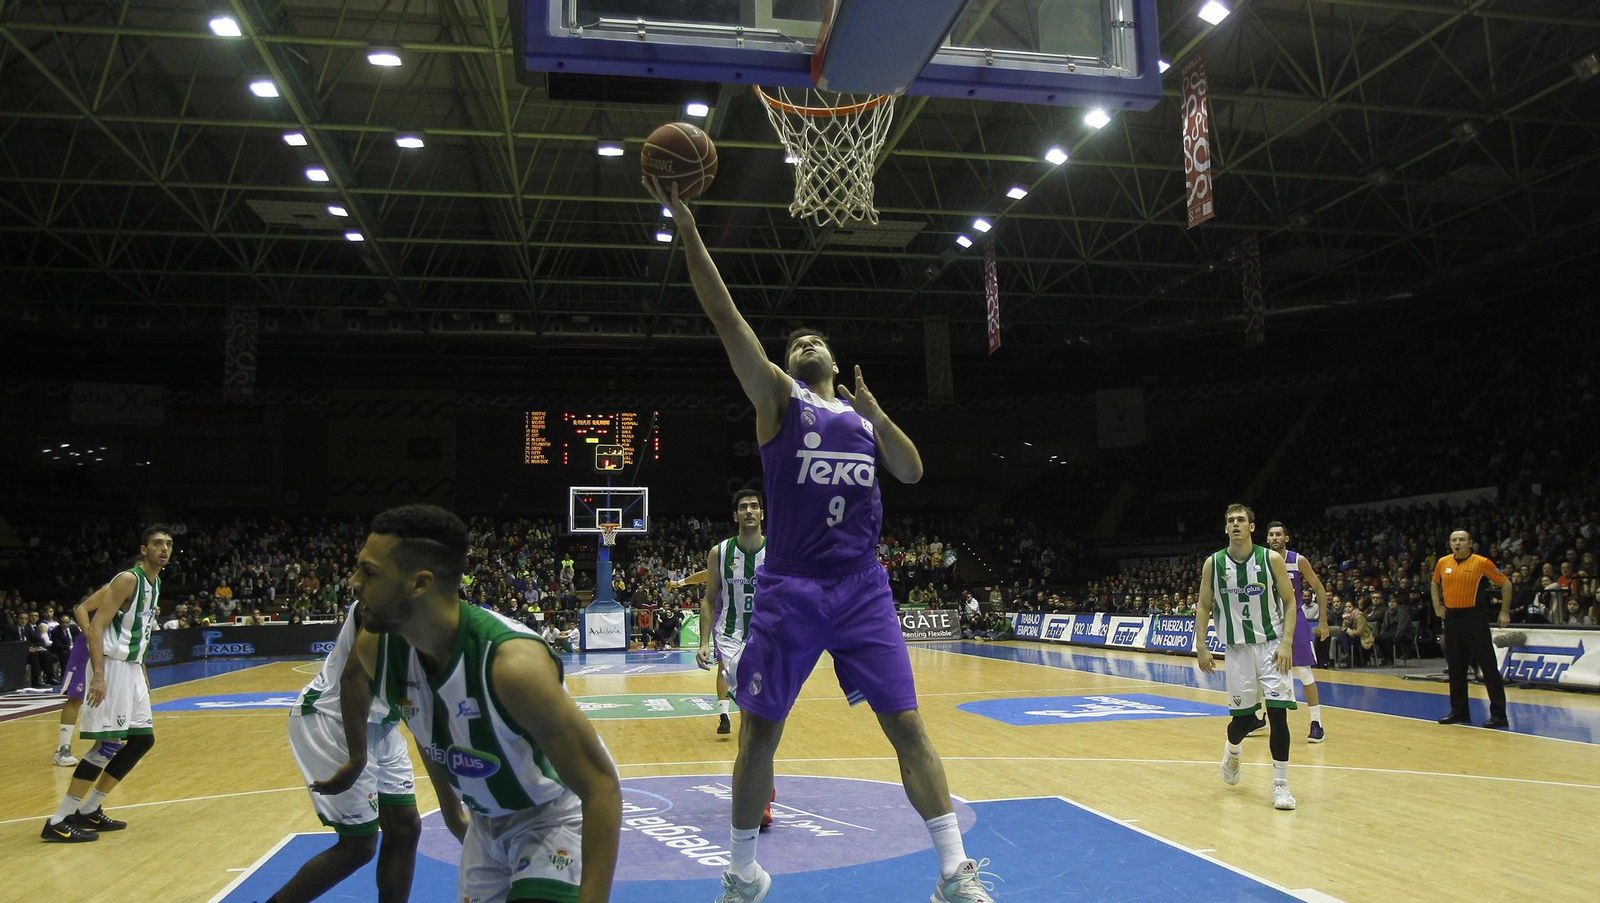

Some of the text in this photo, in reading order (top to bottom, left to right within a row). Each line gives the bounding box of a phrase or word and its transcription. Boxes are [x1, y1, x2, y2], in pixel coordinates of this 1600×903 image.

[826, 496, 846, 527] 9
[1246, 586, 1260, 594] plus
[744, 595, 753, 611] 8
[1242, 604, 1250, 619] 4
[1021, 613, 1040, 625] TRABAJO
[1161, 619, 1184, 632] FUERZA
[1184, 620, 1195, 633] DE
[902, 631, 927, 639] Renting
[1017, 625, 1039, 637] TEMPORAL
[1074, 622, 1085, 635] 902
[1162, 634, 1188, 648] EQUIPO
[452, 753, 485, 769] plus
